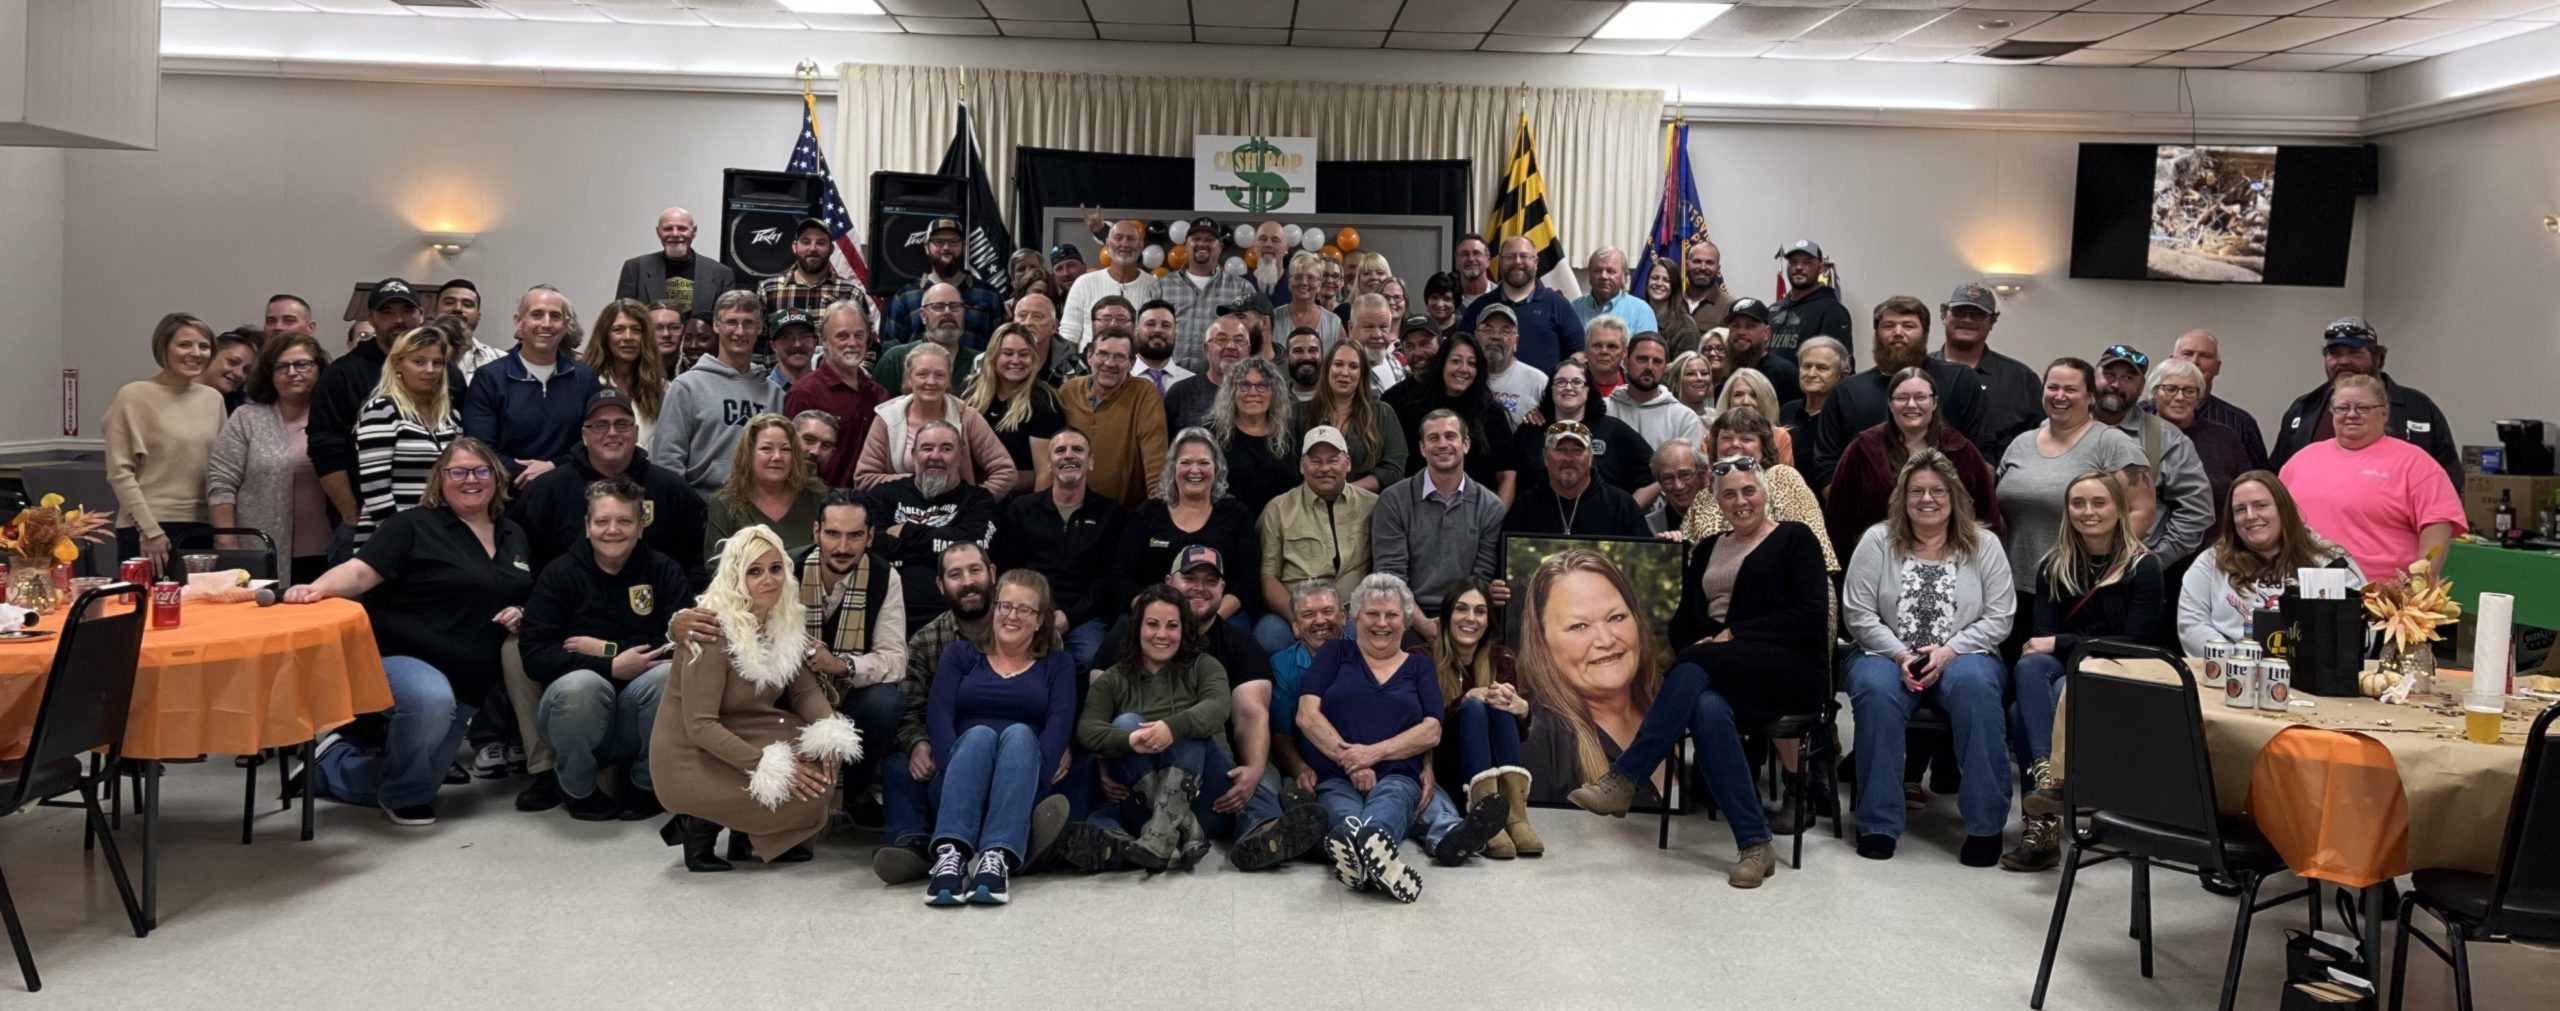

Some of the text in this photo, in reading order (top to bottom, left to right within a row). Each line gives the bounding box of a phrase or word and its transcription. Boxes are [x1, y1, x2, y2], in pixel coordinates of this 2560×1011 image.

[1214, 151, 1303, 173] CASH POP
[723, 399, 764, 426] CAT
